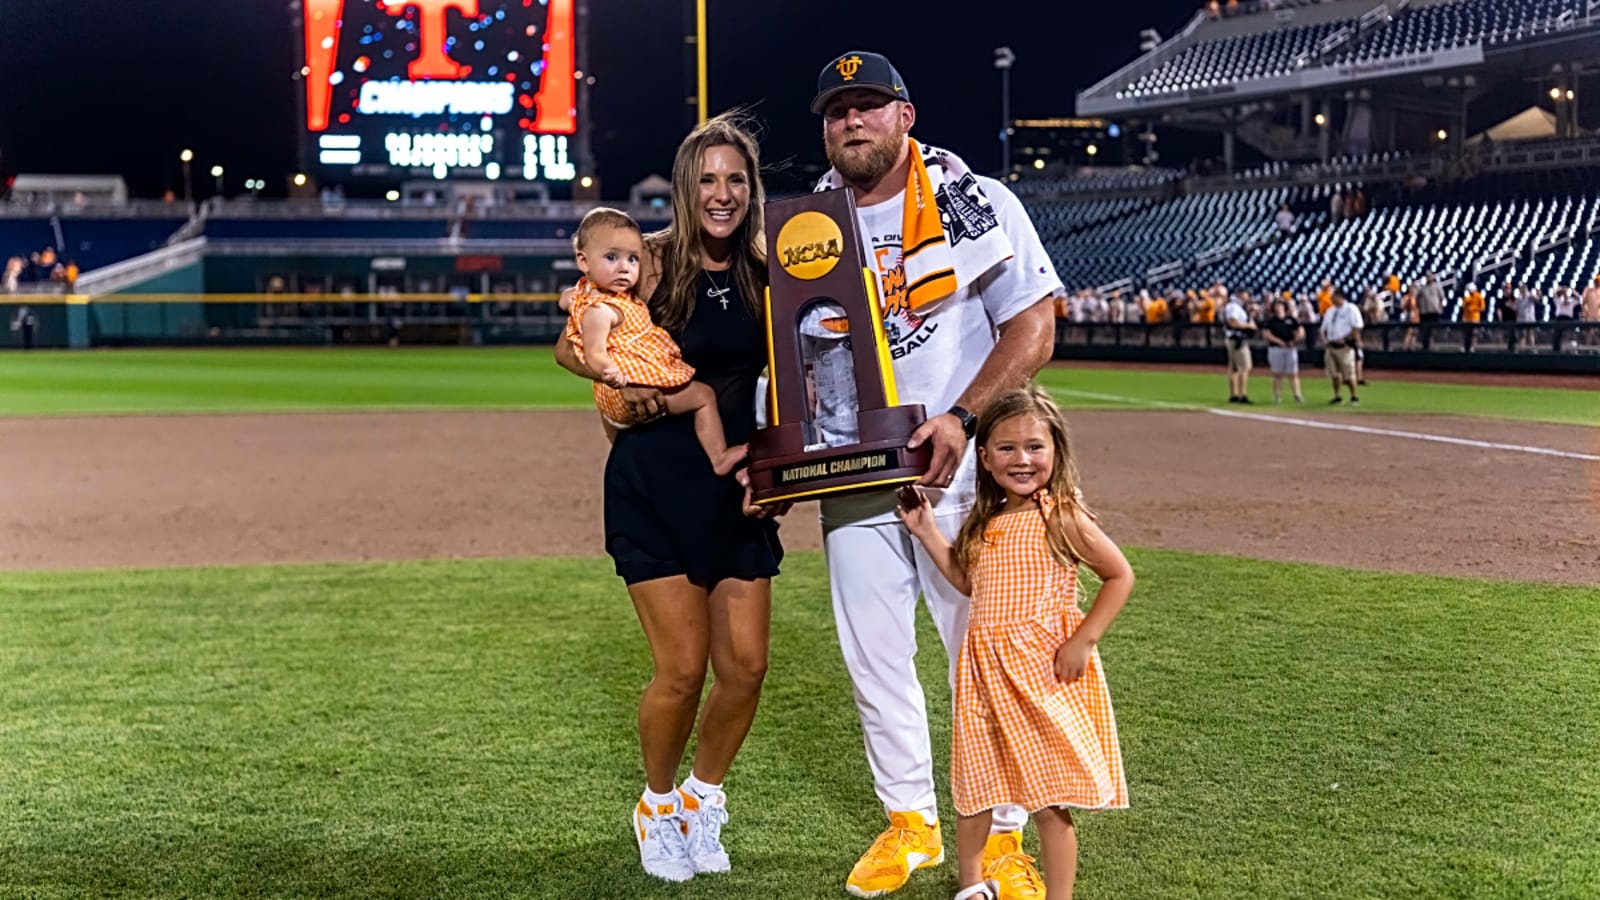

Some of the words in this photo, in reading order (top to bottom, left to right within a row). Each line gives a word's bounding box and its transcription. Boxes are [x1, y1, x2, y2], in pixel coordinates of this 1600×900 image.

[783, 238, 840, 268] NCAA
[782, 462, 828, 482] NATIONAL
[830, 454, 886, 473] CHAMPION
